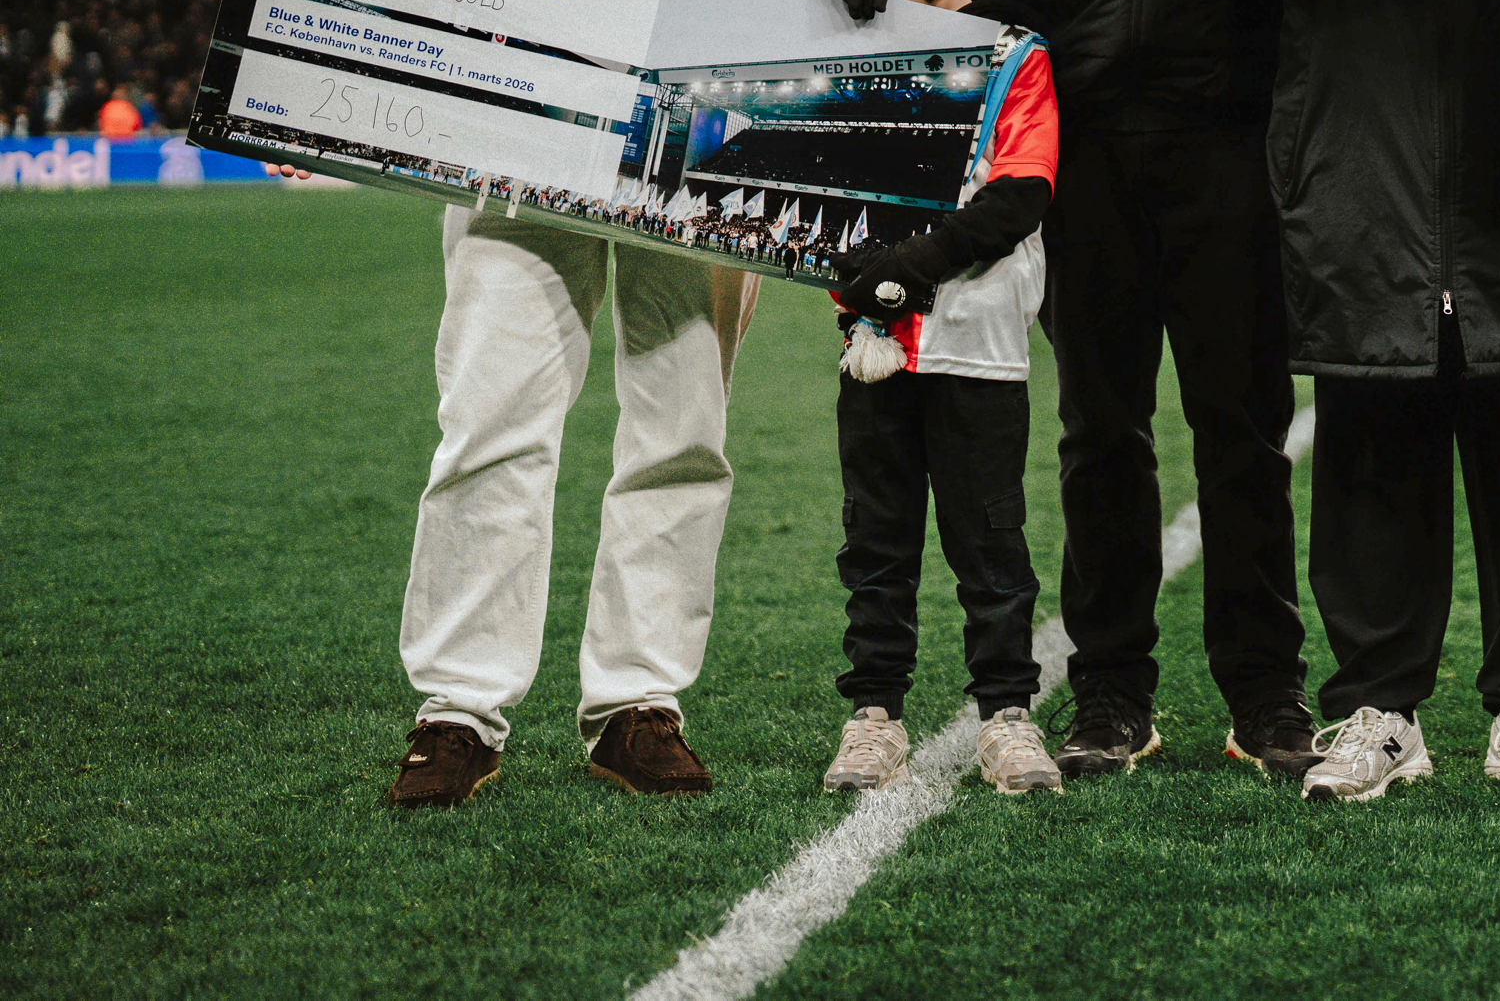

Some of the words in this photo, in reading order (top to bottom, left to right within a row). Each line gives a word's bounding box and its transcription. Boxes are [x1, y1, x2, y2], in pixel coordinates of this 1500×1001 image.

[268, 6, 301, 23] Blue
[304, 15, 314, 27] &
[319, 17, 359, 37] White
[363, 28, 414, 49] Banner
[417, 40, 444, 59] Day
[265, 22, 286, 36] F.C.
[290, 28, 357, 52] København
[360, 46, 375, 56] vs.
[378, 48, 427, 68] Randers
[430, 60, 447, 72] FC
[457, 66, 464, 77] 1.
[468, 70, 502, 85] marts
[504, 77, 535, 92] 2026
[813, 63, 844, 75] MED
[849, 58, 915, 74] HOLDET
[246, 97, 289, 116] Beløb:
[231, 132, 277, 149] HORKRAM
